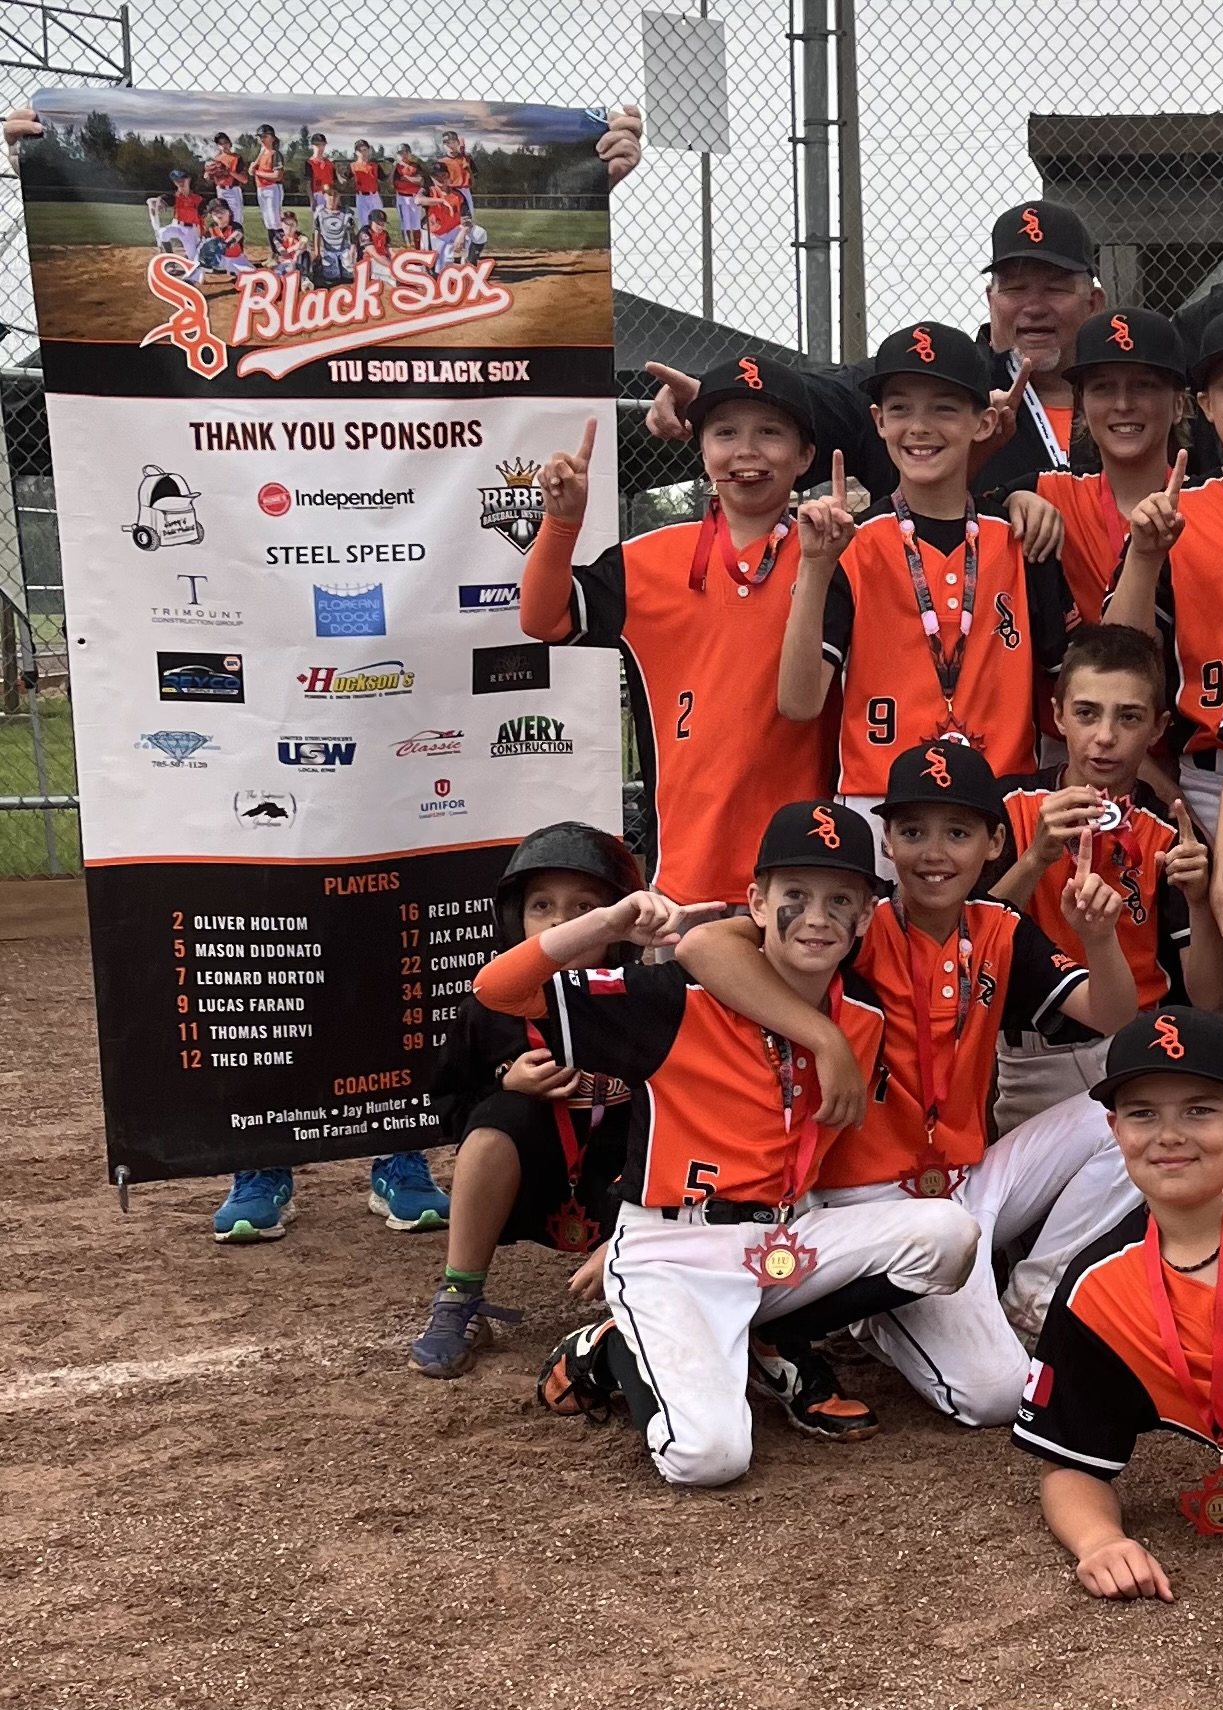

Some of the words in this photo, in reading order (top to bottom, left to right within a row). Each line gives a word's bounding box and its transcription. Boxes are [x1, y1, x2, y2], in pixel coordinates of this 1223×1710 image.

[231, 258, 384, 347] Black
[389, 250, 500, 312] Sox
[328, 361, 363, 382] 11U
[367, 361, 409, 382] SOO
[411, 360, 484, 383] BLACK
[488, 360, 531, 382] SOX
[189, 422, 276, 451] THANK
[281, 421, 335, 450] YOU
[344, 420, 483, 450] SPONSORS
[295, 488, 415, 510] Independent
[482, 487, 545, 512] REBE
[266, 545, 341, 565] STEEL
[346, 543, 427, 563] SPEED
[177, 574, 208, 606] T
[479, 588, 520, 603] WIN
[151, 608, 243, 618] TRIMOUNT
[151, 617, 214, 626] CONSTRUCTION
[330, 623, 374, 634] DOOL
[304, 667, 415, 693] Huckson's
[490, 671, 533, 683] REVIVE
[675, 690, 695, 741] 2
[867, 696, 897, 746] 9
[497, 715, 565, 743] AVERY
[277, 742, 357, 766] USW
[490, 742, 573, 755] CONSTRUCTION
[324, 872, 400, 895] PLAYERS
[399, 903, 419, 921] 16
[428, 902, 460, 918] REID
[465, 898, 494, 914] ENT
[172, 911, 184, 930] 2
[194, 915, 245, 931] OLIVER
[250, 917, 308, 931] HOLTOM
[174, 939, 186, 958] 5
[195, 944, 245, 958] MASON
[250, 944, 322, 958] DIDONATO
[401, 929, 420, 948] 17
[429, 930, 451, 945] JAX
[401, 956, 422, 975] 22
[431, 951, 485, 971] CONNOR
[175, 967, 186, 986] 7
[196, 971, 262, 986] LEONARD
[268, 970, 325, 985] HORTON
[402, 982, 423, 1001] 34
[431, 979, 473, 997] JACOB
[177, 994, 189, 1014] 9
[198, 999, 244, 1013] LUCAS
[250, 997, 305, 1012] FARAND
[402, 1007, 423, 1025] 49
[432, 1006, 461, 1022] REE
[178, 1022, 198, 1041] 11
[209, 1025, 268, 1040] THOMAS
[272, 1024, 313, 1039] HIRVI
[403, 1032, 424, 1051] 99
[180, 1049, 202, 1069] 12
[211, 1052, 248, 1067] THEO
[253, 1051, 294, 1066] ROME
[334, 1069, 412, 1096] COACHES
[230, 1113, 264, 1130] Ryan
[266, 1107, 327, 1124] Palahnuk
[342, 1104, 363, 1118] Jay
[365, 1098, 408, 1115] Hunter
[292, 1126, 320, 1141] Tom
[323, 1121, 368, 1138] Farand
[383, 1114, 417, 1131] Chris
[683, 1159, 720, 1206] 5
